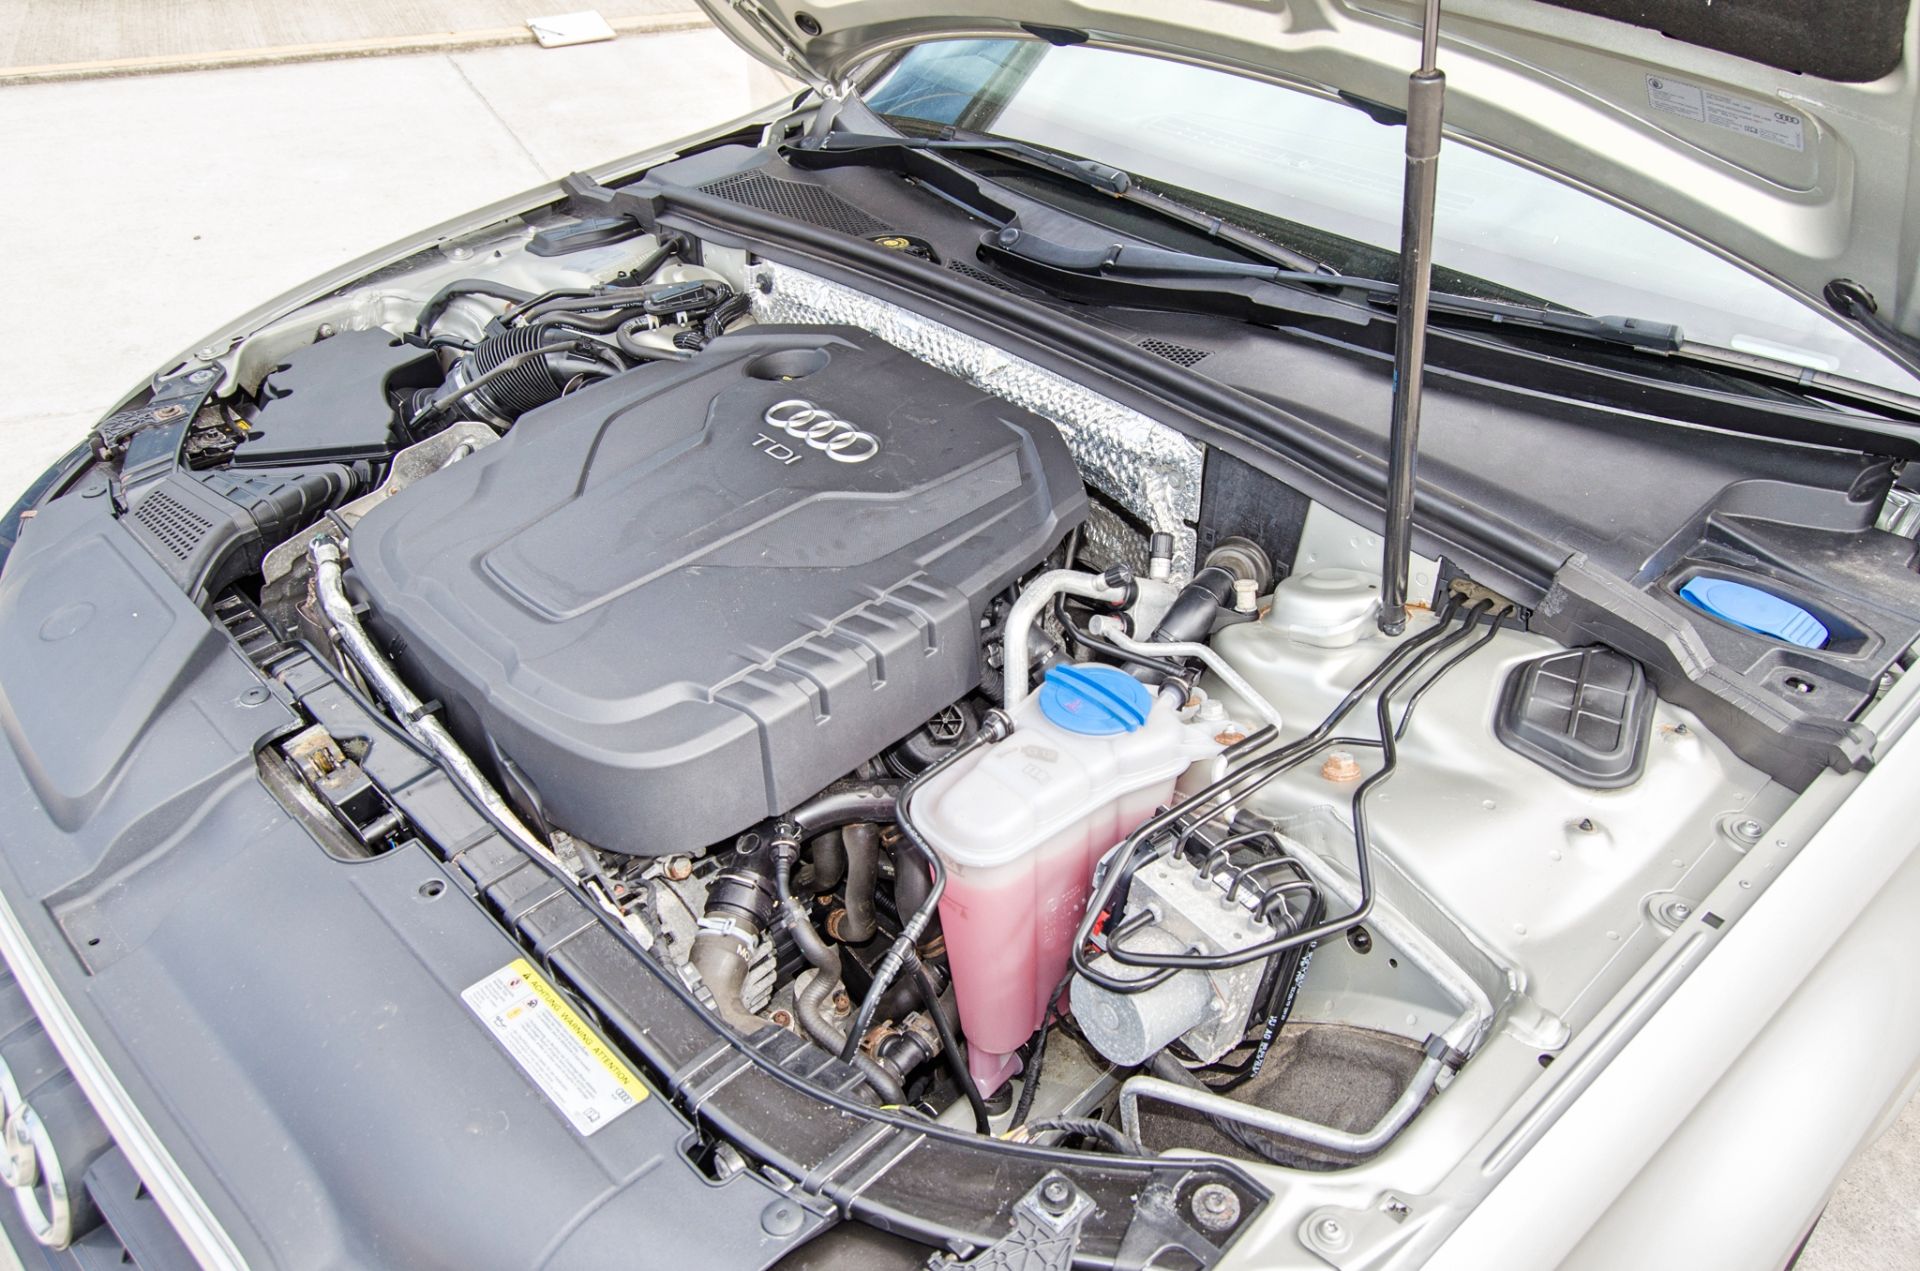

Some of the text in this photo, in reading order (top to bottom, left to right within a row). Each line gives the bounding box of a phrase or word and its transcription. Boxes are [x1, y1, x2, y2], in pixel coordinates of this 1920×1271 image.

[751, 432, 802, 465] TDI
[531, 980, 562, 1012] ACHTUNG
[560, 1011, 593, 1046] WARNING
[593, 1047, 631, 1085] ATTENTION
